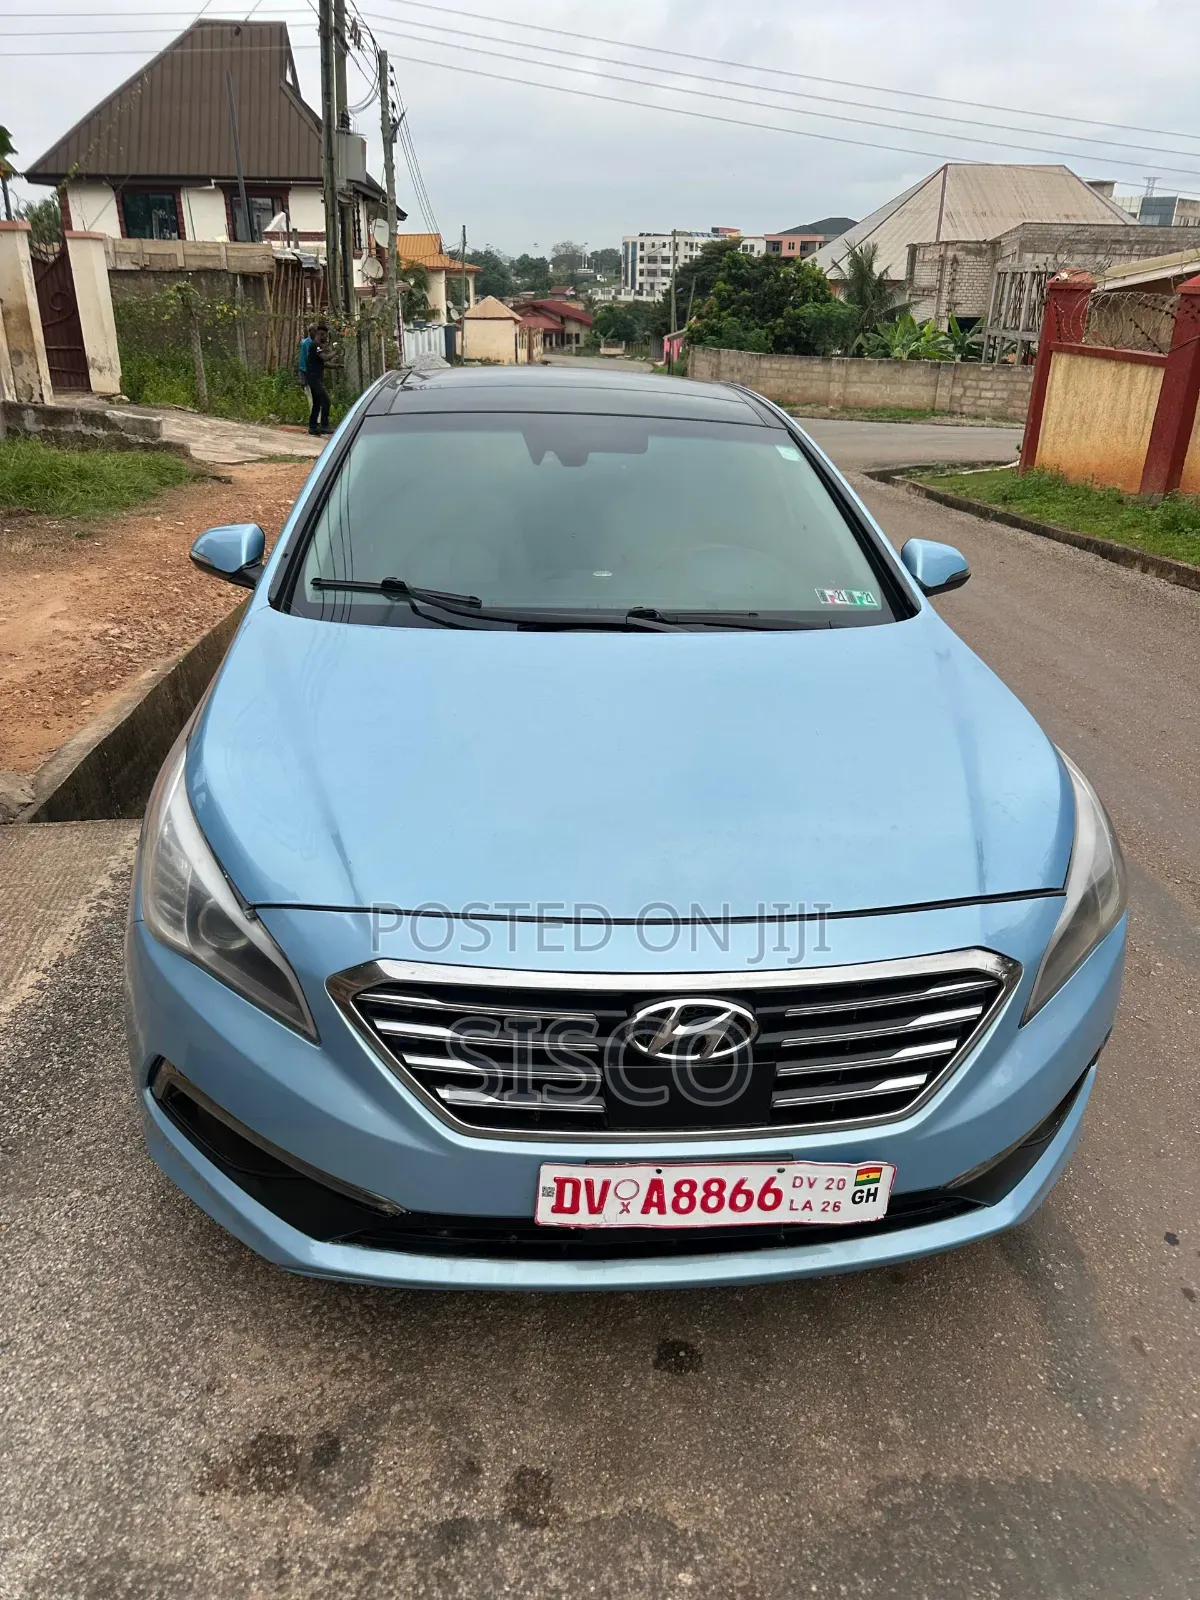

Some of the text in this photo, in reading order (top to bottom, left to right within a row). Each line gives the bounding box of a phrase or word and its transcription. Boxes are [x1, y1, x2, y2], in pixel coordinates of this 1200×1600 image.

[792, 1175, 847, 1191] DV 20
[551, 1176, 784, 1215] DV A8866
[851, 1187, 879, 1205] GH
[789, 1199, 842, 1213] LA 26
